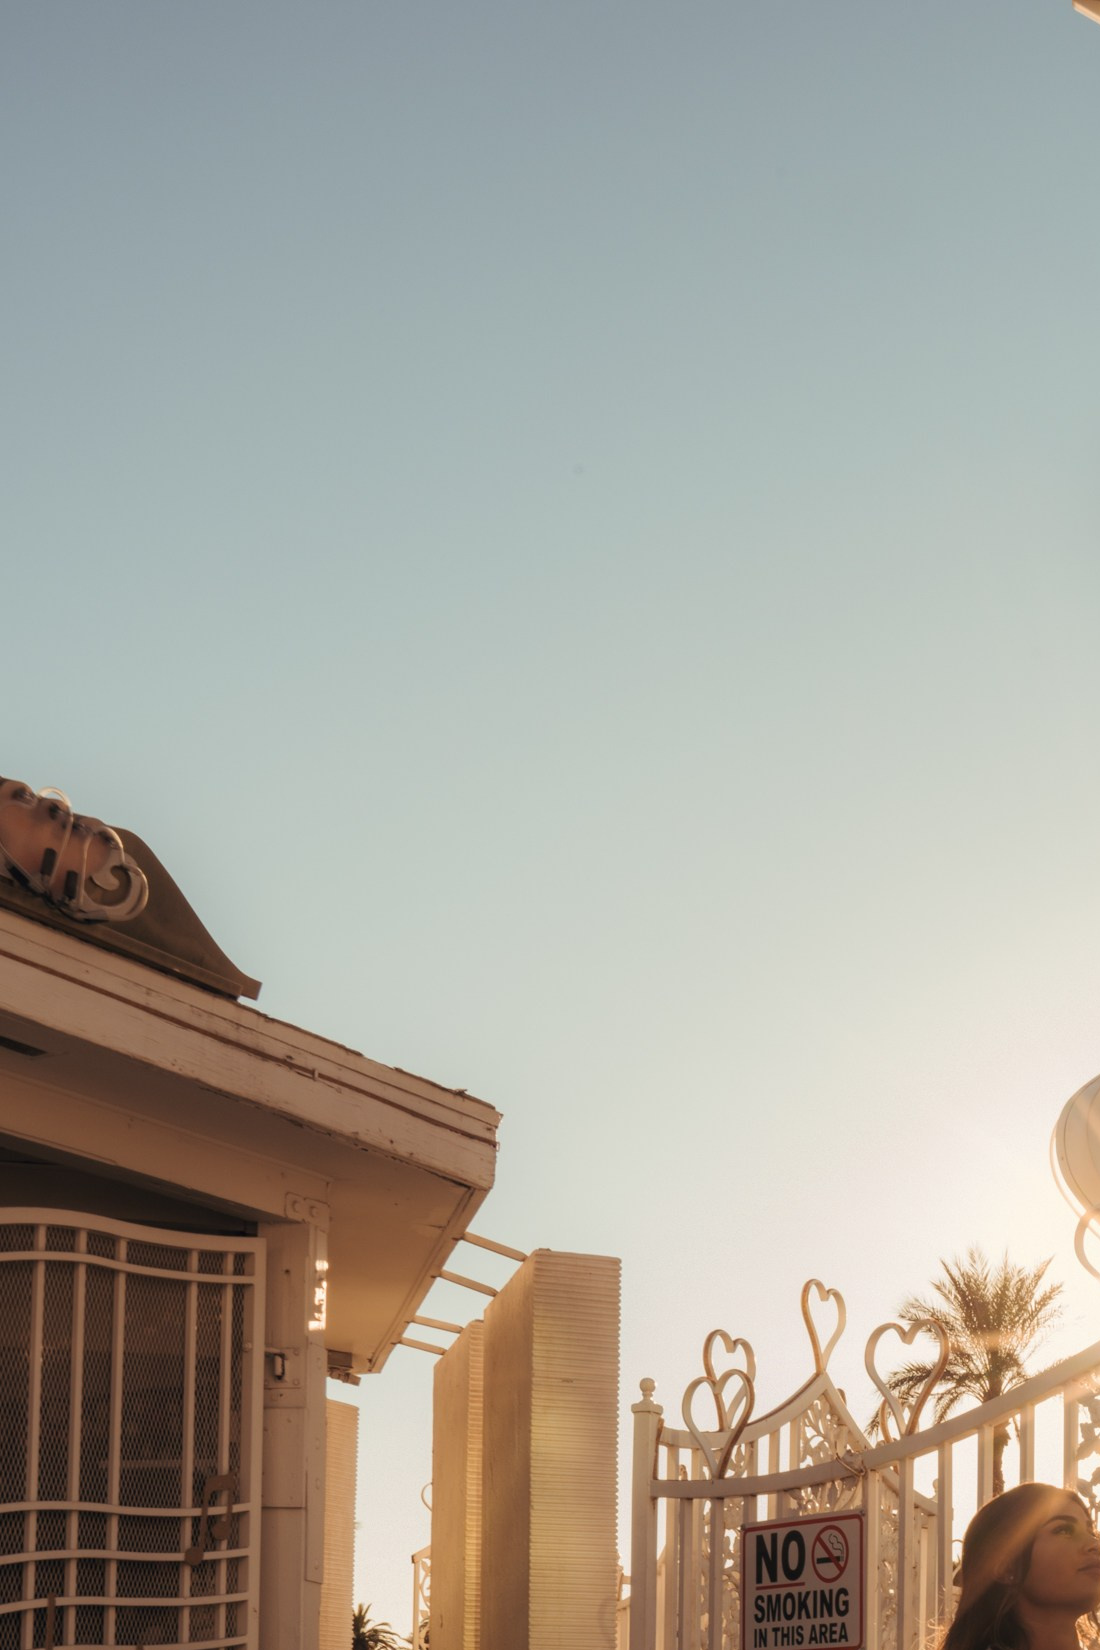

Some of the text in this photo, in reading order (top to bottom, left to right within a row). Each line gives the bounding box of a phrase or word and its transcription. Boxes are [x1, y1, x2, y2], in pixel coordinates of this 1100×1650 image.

[756, 1530, 805, 1584] NO
[754, 1587, 849, 1623] SMOKING
[754, 1622, 849, 1648] IN THIS AREA
